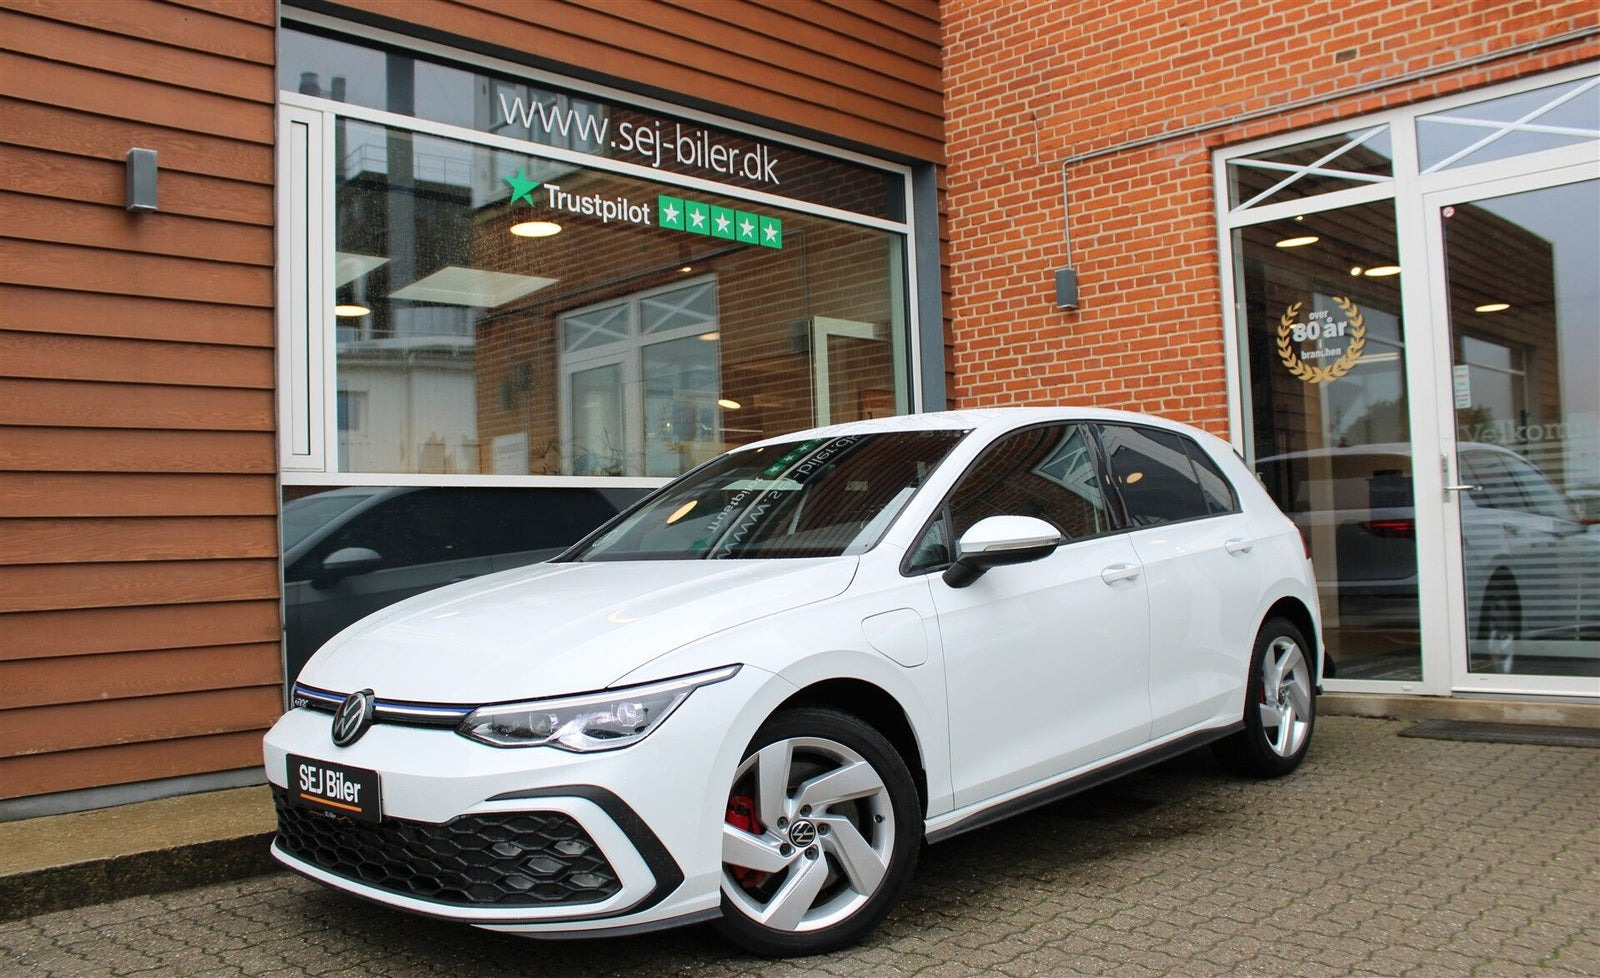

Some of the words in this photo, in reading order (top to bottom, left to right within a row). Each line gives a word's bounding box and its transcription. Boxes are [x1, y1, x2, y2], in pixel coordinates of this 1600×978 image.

[499, 93, 780, 184] www.sej-biler.dk
[543, 183, 650, 225] Trustpilot
[1293, 321, 1320, 342] 80
[1323, 316, 1347, 338] år
[1309, 310, 1329, 320] over
[299, 764, 323, 795] SEJ
[326, 770, 361, 803] Biler
